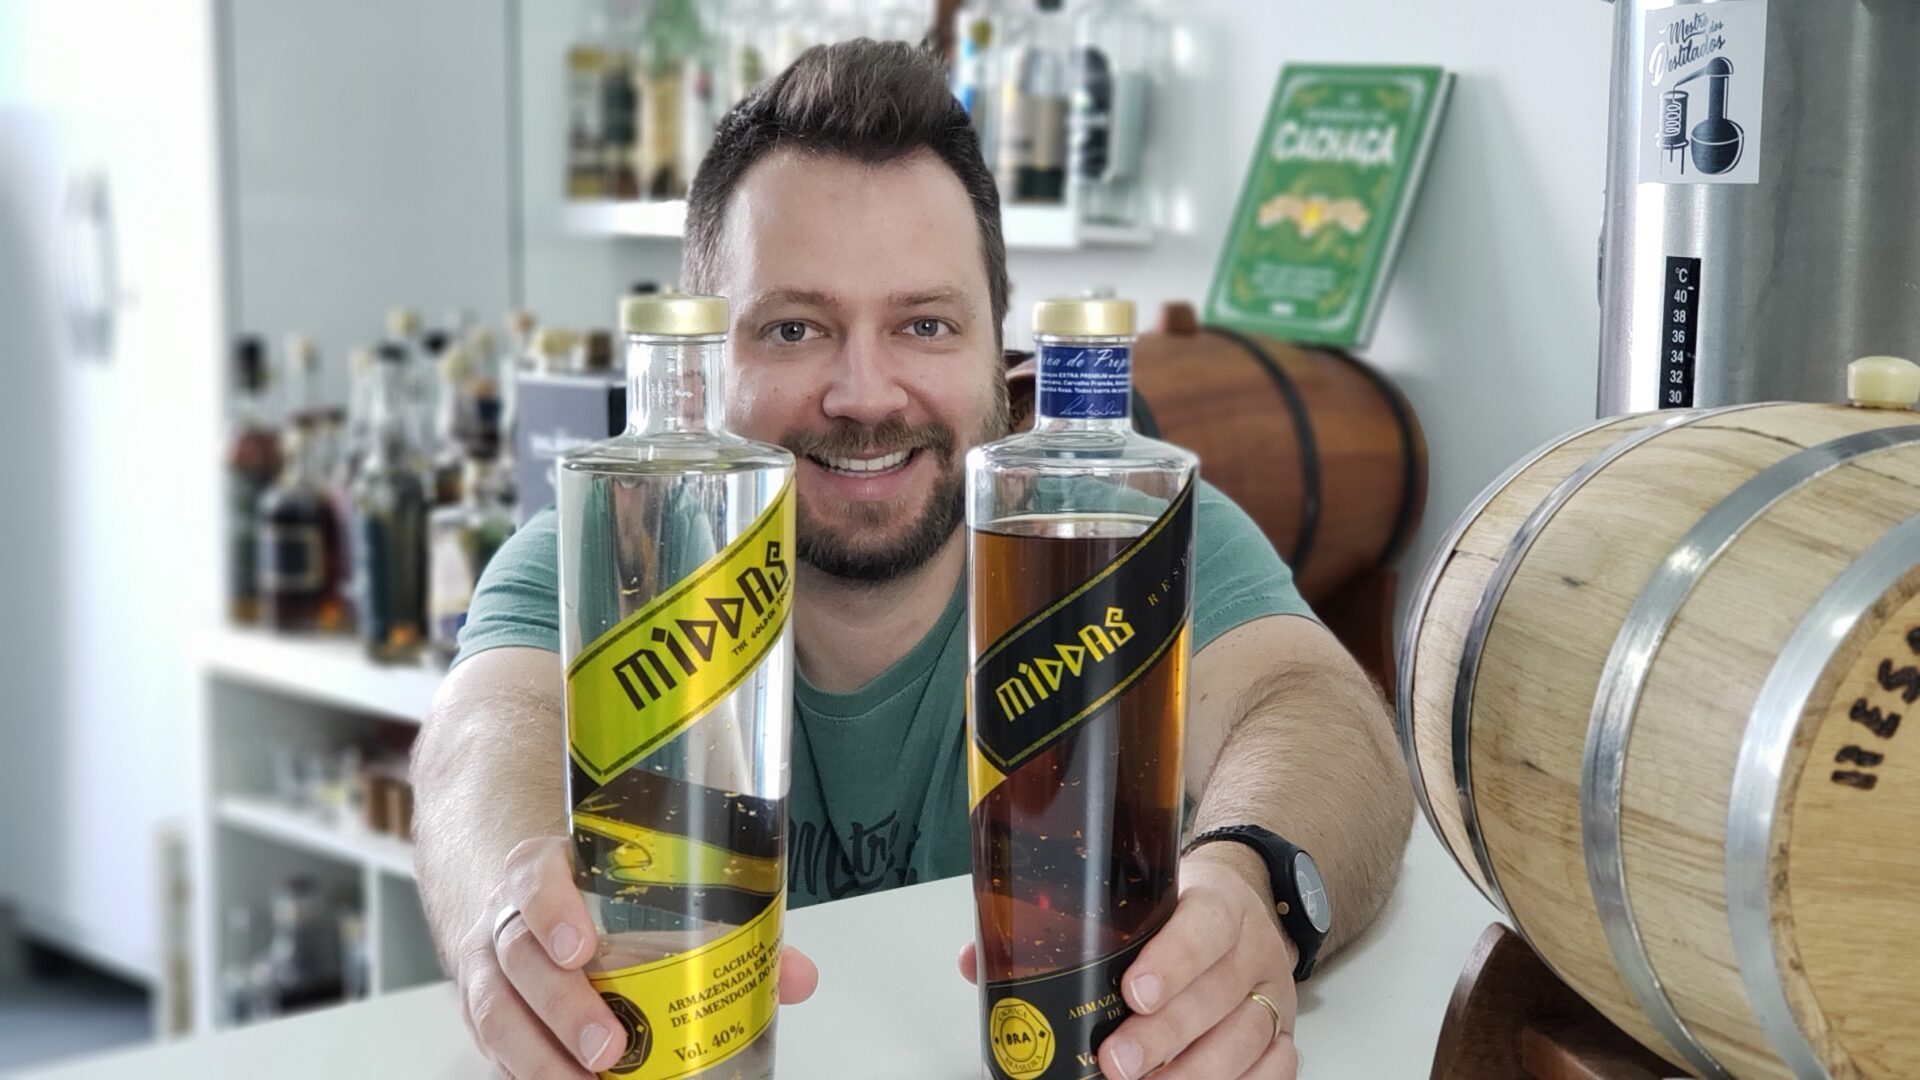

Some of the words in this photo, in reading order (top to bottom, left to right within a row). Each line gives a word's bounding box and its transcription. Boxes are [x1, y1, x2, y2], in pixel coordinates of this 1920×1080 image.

[1709, 20, 1724, 33] dos
[1649, 34, 1726, 87] Destilados
[1674, 289, 1688, 303] 40
[1673, 309, 1686, 323] 38
[1672, 330, 1685, 343] 36
[1670, 350, 1684, 363] 34
[1669, 370, 1683, 384] 32
[1668, 390, 1682, 403] 30
[731, 639, 748, 656] THE
[751, 608, 776, 639] GOLDEN
[712, 941, 765, 979] CACHAÇA
[668, 967, 753, 1013] ARMAZENADA
[753, 953, 768, 972] EM
[671, 1013, 691, 1028] DE
[694, 978, 757, 1020] AMENDOIM
[758, 966, 770, 983] DO
[673, 1042, 708, 1062] Vol.
[712, 1020, 745, 1048] 40%
[1006, 1031, 1031, 1046] BRA
